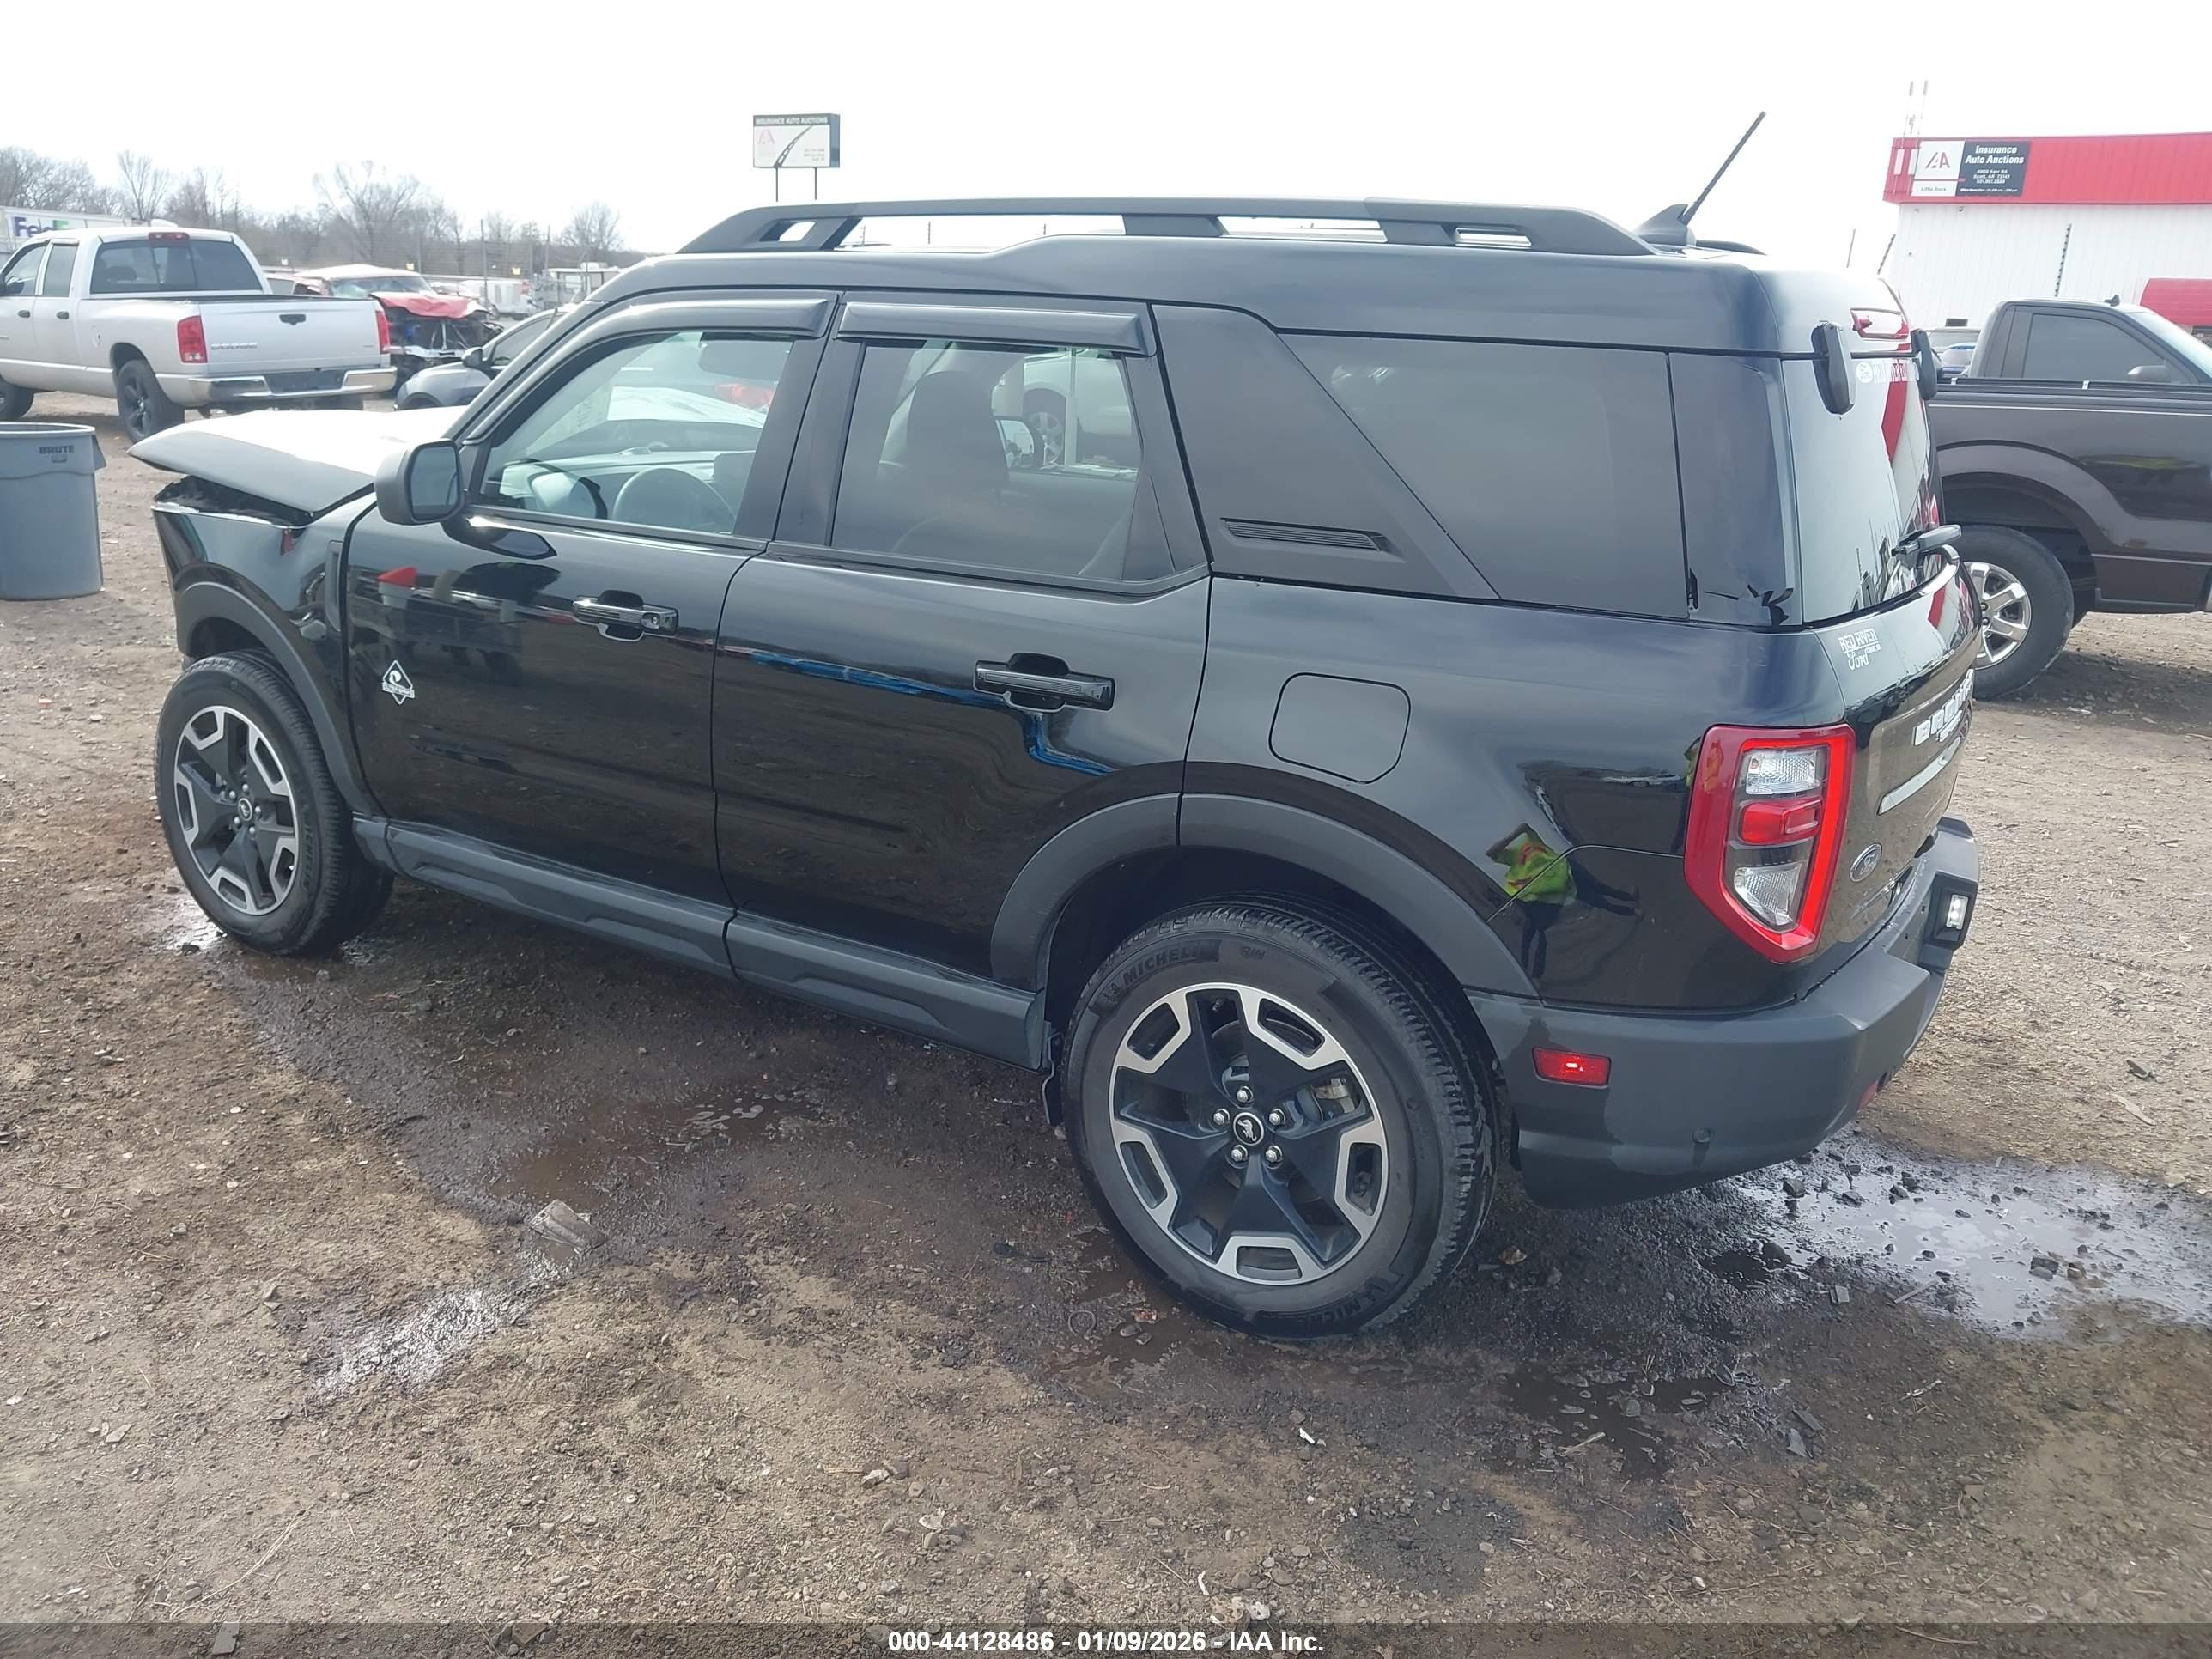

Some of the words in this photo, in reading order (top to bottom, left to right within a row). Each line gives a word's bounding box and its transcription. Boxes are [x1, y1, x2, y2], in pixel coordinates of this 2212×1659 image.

[1975, 145, 2018, 154] Insurance
[1965, 155, 1985, 164] Auto
[1986, 155, 2025, 164] Auctions
[39, 445, 75, 455] BRUTE
[1838, 634, 1856, 652] RED
[1854, 628, 1878, 647] RIVER
